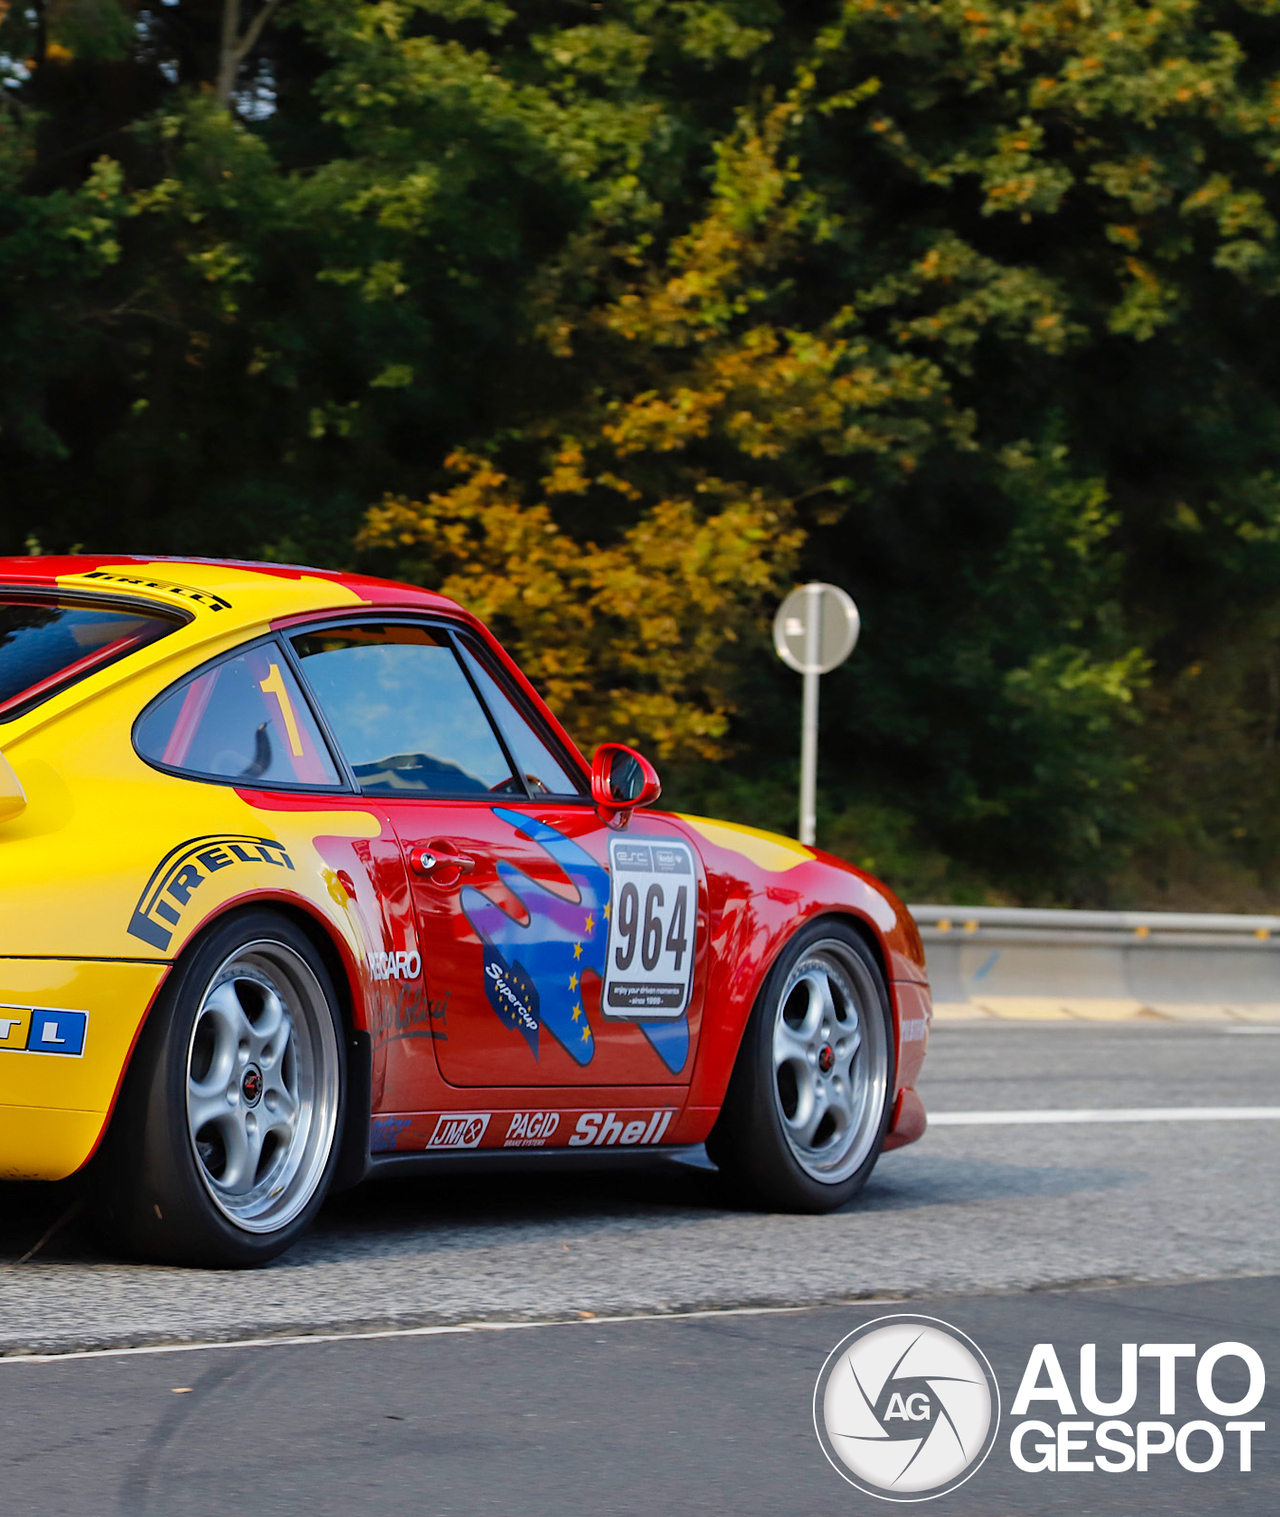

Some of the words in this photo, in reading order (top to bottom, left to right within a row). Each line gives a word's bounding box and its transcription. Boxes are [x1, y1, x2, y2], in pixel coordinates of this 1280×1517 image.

[84, 572, 233, 612] PIRELLI
[259, 664, 304, 756] 1
[126, 834, 296, 952] PIRELLI
[615, 881, 687, 971] 964
[370, 951, 421, 980] RECARO
[485, 962, 539, 1031] Supercup
[505, 1112, 560, 1139] PAGID
[568, 1111, 673, 1147] Shell
